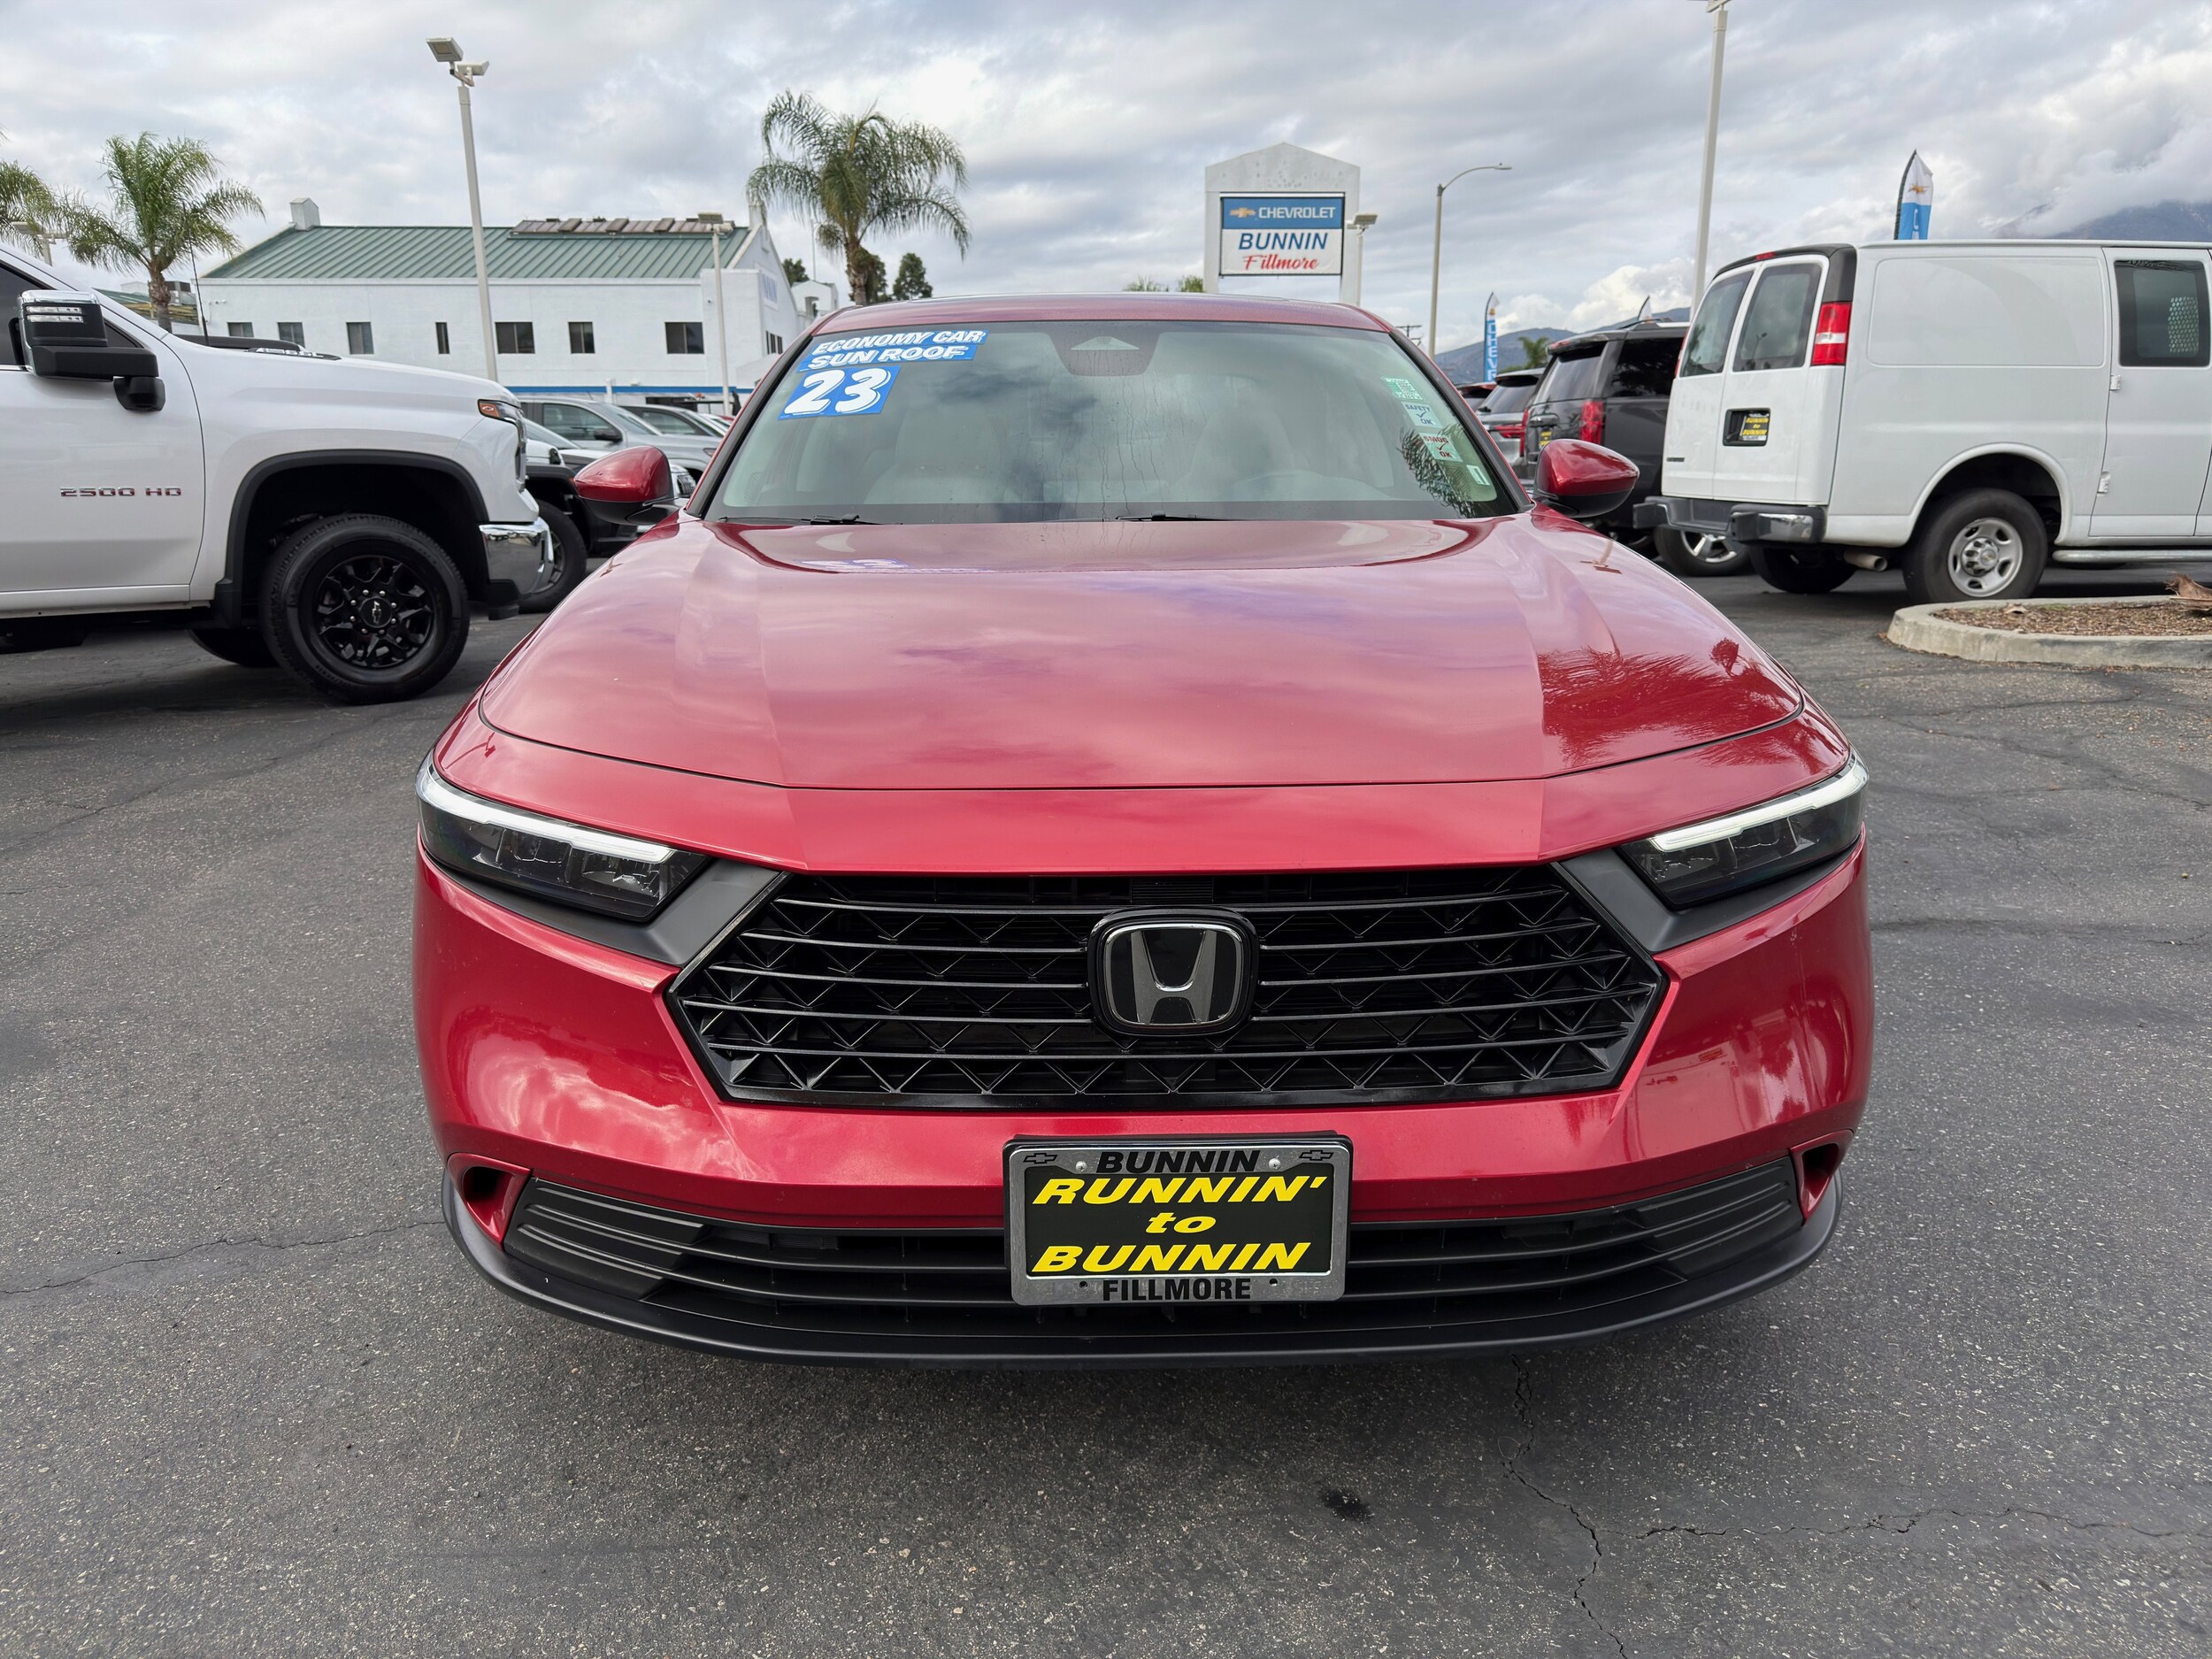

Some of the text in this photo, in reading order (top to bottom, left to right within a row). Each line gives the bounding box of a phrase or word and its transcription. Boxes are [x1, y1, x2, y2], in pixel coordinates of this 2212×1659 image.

[1258, 206, 1336, 219] CHEVROLET
[1238, 232, 1329, 250] BUNNIN
[1241, 253, 1319, 271] Fillmore
[811, 330, 986, 356] ECONOMY CAR
[808, 345, 969, 370] SUN ROOF
[784, 367, 892, 416] 23
[1404, 403, 1431, 412] SAFETY
[60, 487, 182, 497] 2500 HD
[1095, 1149, 1261, 1173] BUNNIN
[1032, 1175, 1329, 1205] RUNNIN'
[1145, 1211, 1217, 1233] to
[1031, 1241, 1312, 1273] BUNNIN
[1102, 1278, 1252, 1302] FILLMORE
